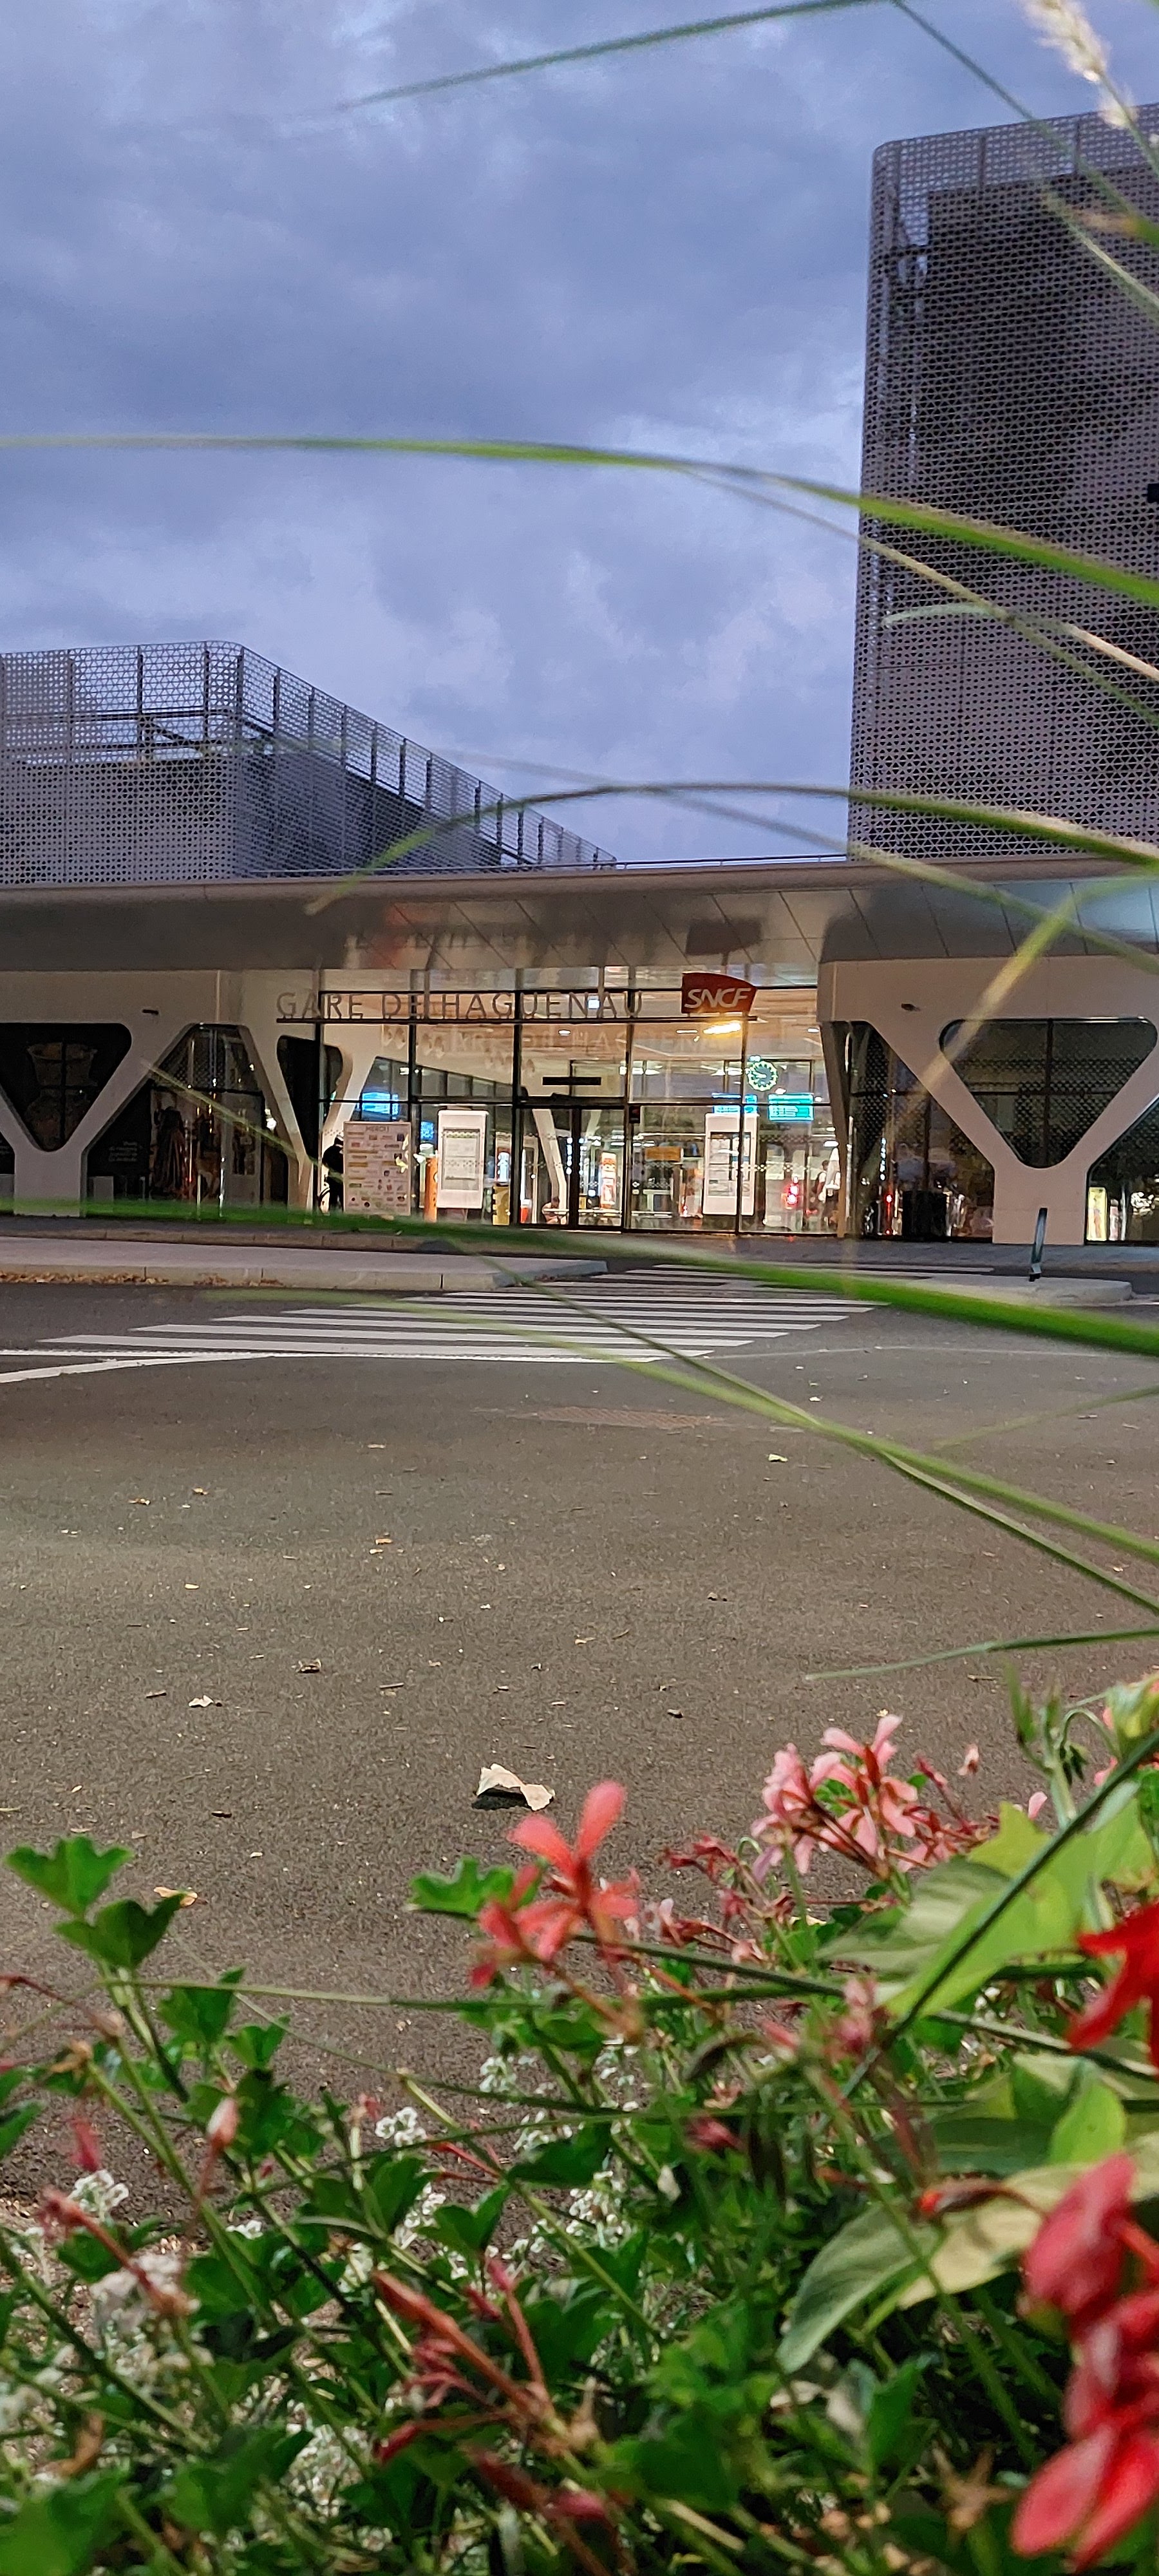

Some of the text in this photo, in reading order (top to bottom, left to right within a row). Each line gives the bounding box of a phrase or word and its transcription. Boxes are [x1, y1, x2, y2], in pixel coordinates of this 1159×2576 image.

[276, 990, 643, 1018] GARE DE HAGUENAU
[684, 988, 751, 1009] SNCF
